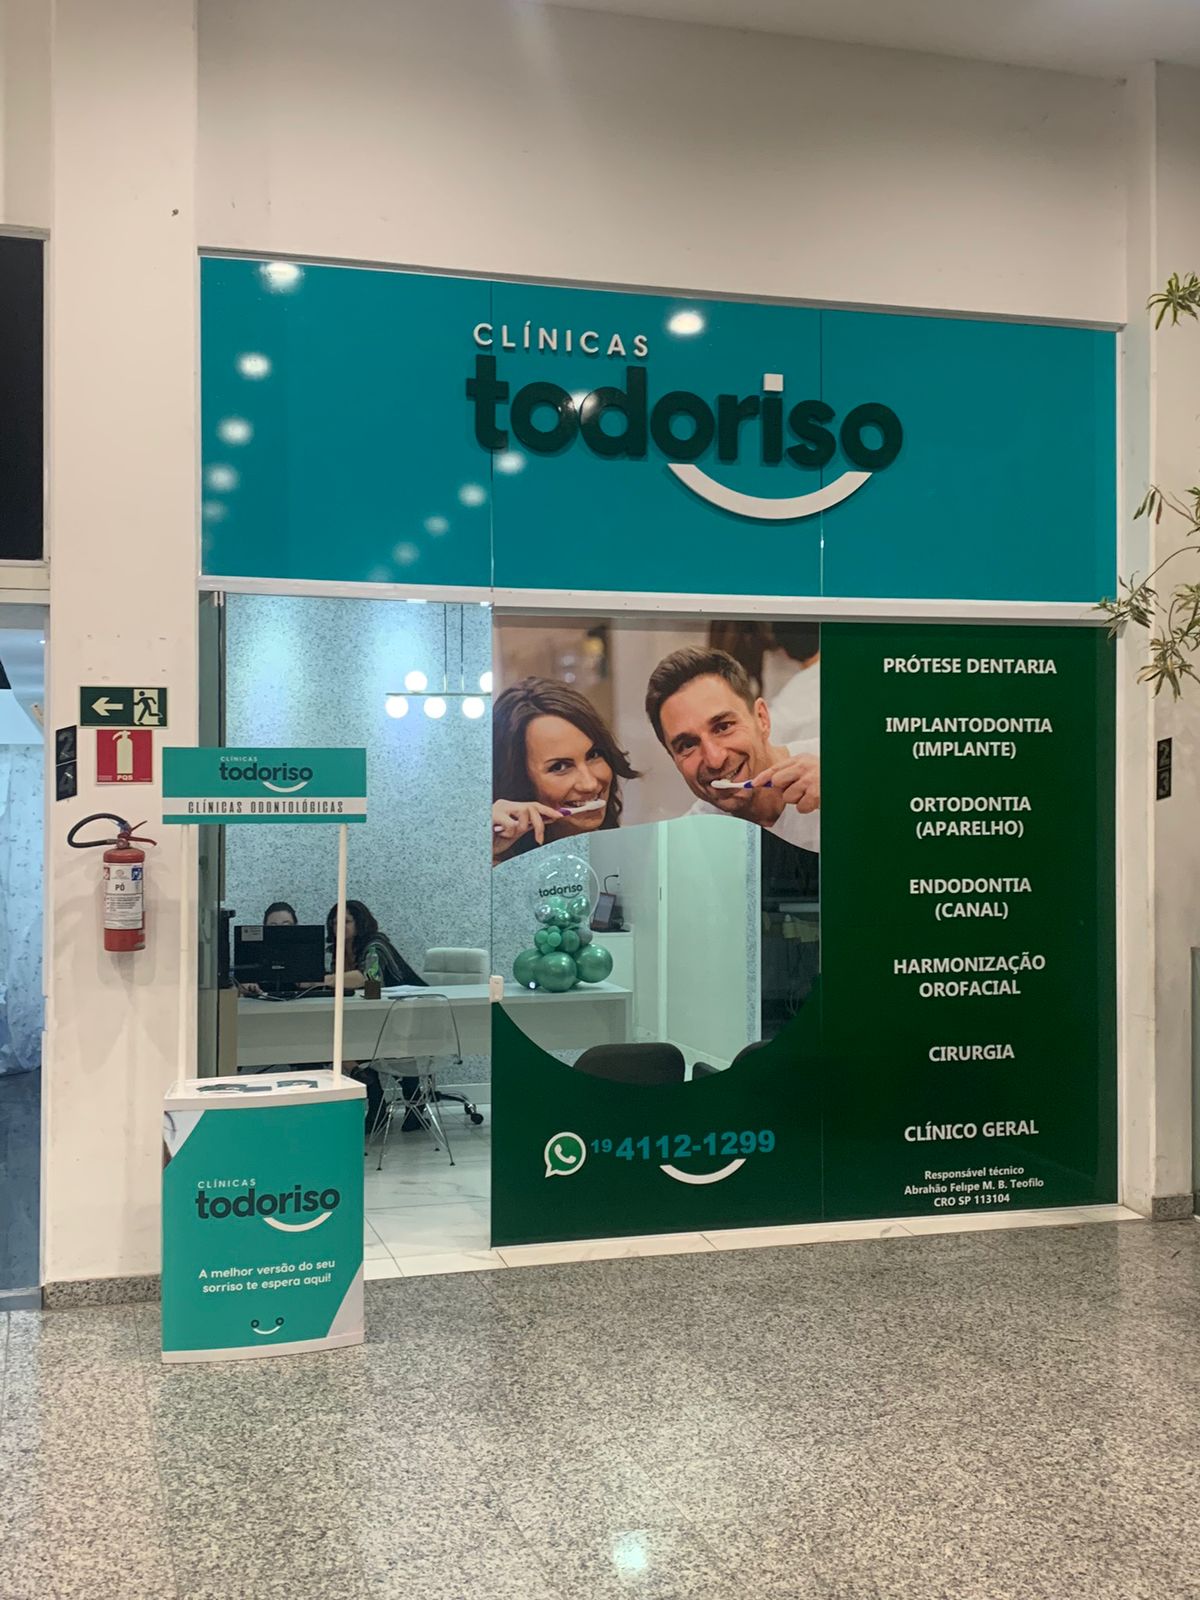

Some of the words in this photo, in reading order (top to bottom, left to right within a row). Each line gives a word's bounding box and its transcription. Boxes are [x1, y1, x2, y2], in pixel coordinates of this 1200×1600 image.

[473, 321, 649, 357] CLÍNICAS
[466, 354, 903, 469] todoriso
[883, 654, 961, 673] PRÓTESE
[966, 659, 1057, 674] DENTARIA
[885, 717, 1053, 733] IMPLANTODONTIA
[912, 741, 1017, 759] (IMPLANTE)
[219, 762, 313, 781] todoriso
[188, 799, 242, 813] CLÍNICAS
[250, 799, 344, 813] ODONTOLÓGICAS
[910, 796, 1032, 812] ORTODONTIA
[916, 820, 1024, 839] (APARELHO)
[538, 884, 583, 897] todoriso
[909, 878, 1032, 894] ENDODONTIA
[935, 902, 1009, 920] (CANAL)
[893, 952, 1046, 974] HARMONIZAÇÃO
[919, 980, 1021, 997] OROFACIAL
[928, 1044, 1015, 1061] CIRURGIA
[904, 1121, 977, 1142] CLÍNICO
[982, 1120, 1039, 1137] GERAL
[590, 1138, 612, 1154] 19
[615, 1129, 776, 1160] 4112-1299
[924, 1167, 986, 1181] Responsável
[988, 1165, 1024, 1177] técnico
[197, 1178, 256, 1189] CLÍNICAS
[904, 1183, 948, 1195] Abrahão
[950, 1181, 980, 1193] Felipe
[982, 1181, 995, 1190] M.
[998, 1180, 1008, 1189] B.
[1010, 1178, 1045, 1188] Teofilo
[195, 1184, 341, 1219] todoriso
[933, 1197, 956, 1207] CRO
[958, 1196, 971, 1205] SP
[974, 1193, 1010, 1204] 113104
[198, 1269, 208, 1279] A
[211, 1267, 254, 1279] melhor
[257, 1262, 295, 1275] versão
[298, 1261, 313, 1271] do
[316, 1259, 336, 1269] seu
[202, 1281, 243, 1293] sorriso
[246, 1281, 258, 1290] te
[261, 1276, 300, 1290] espera
[303, 1273, 331, 1285] aqui!
